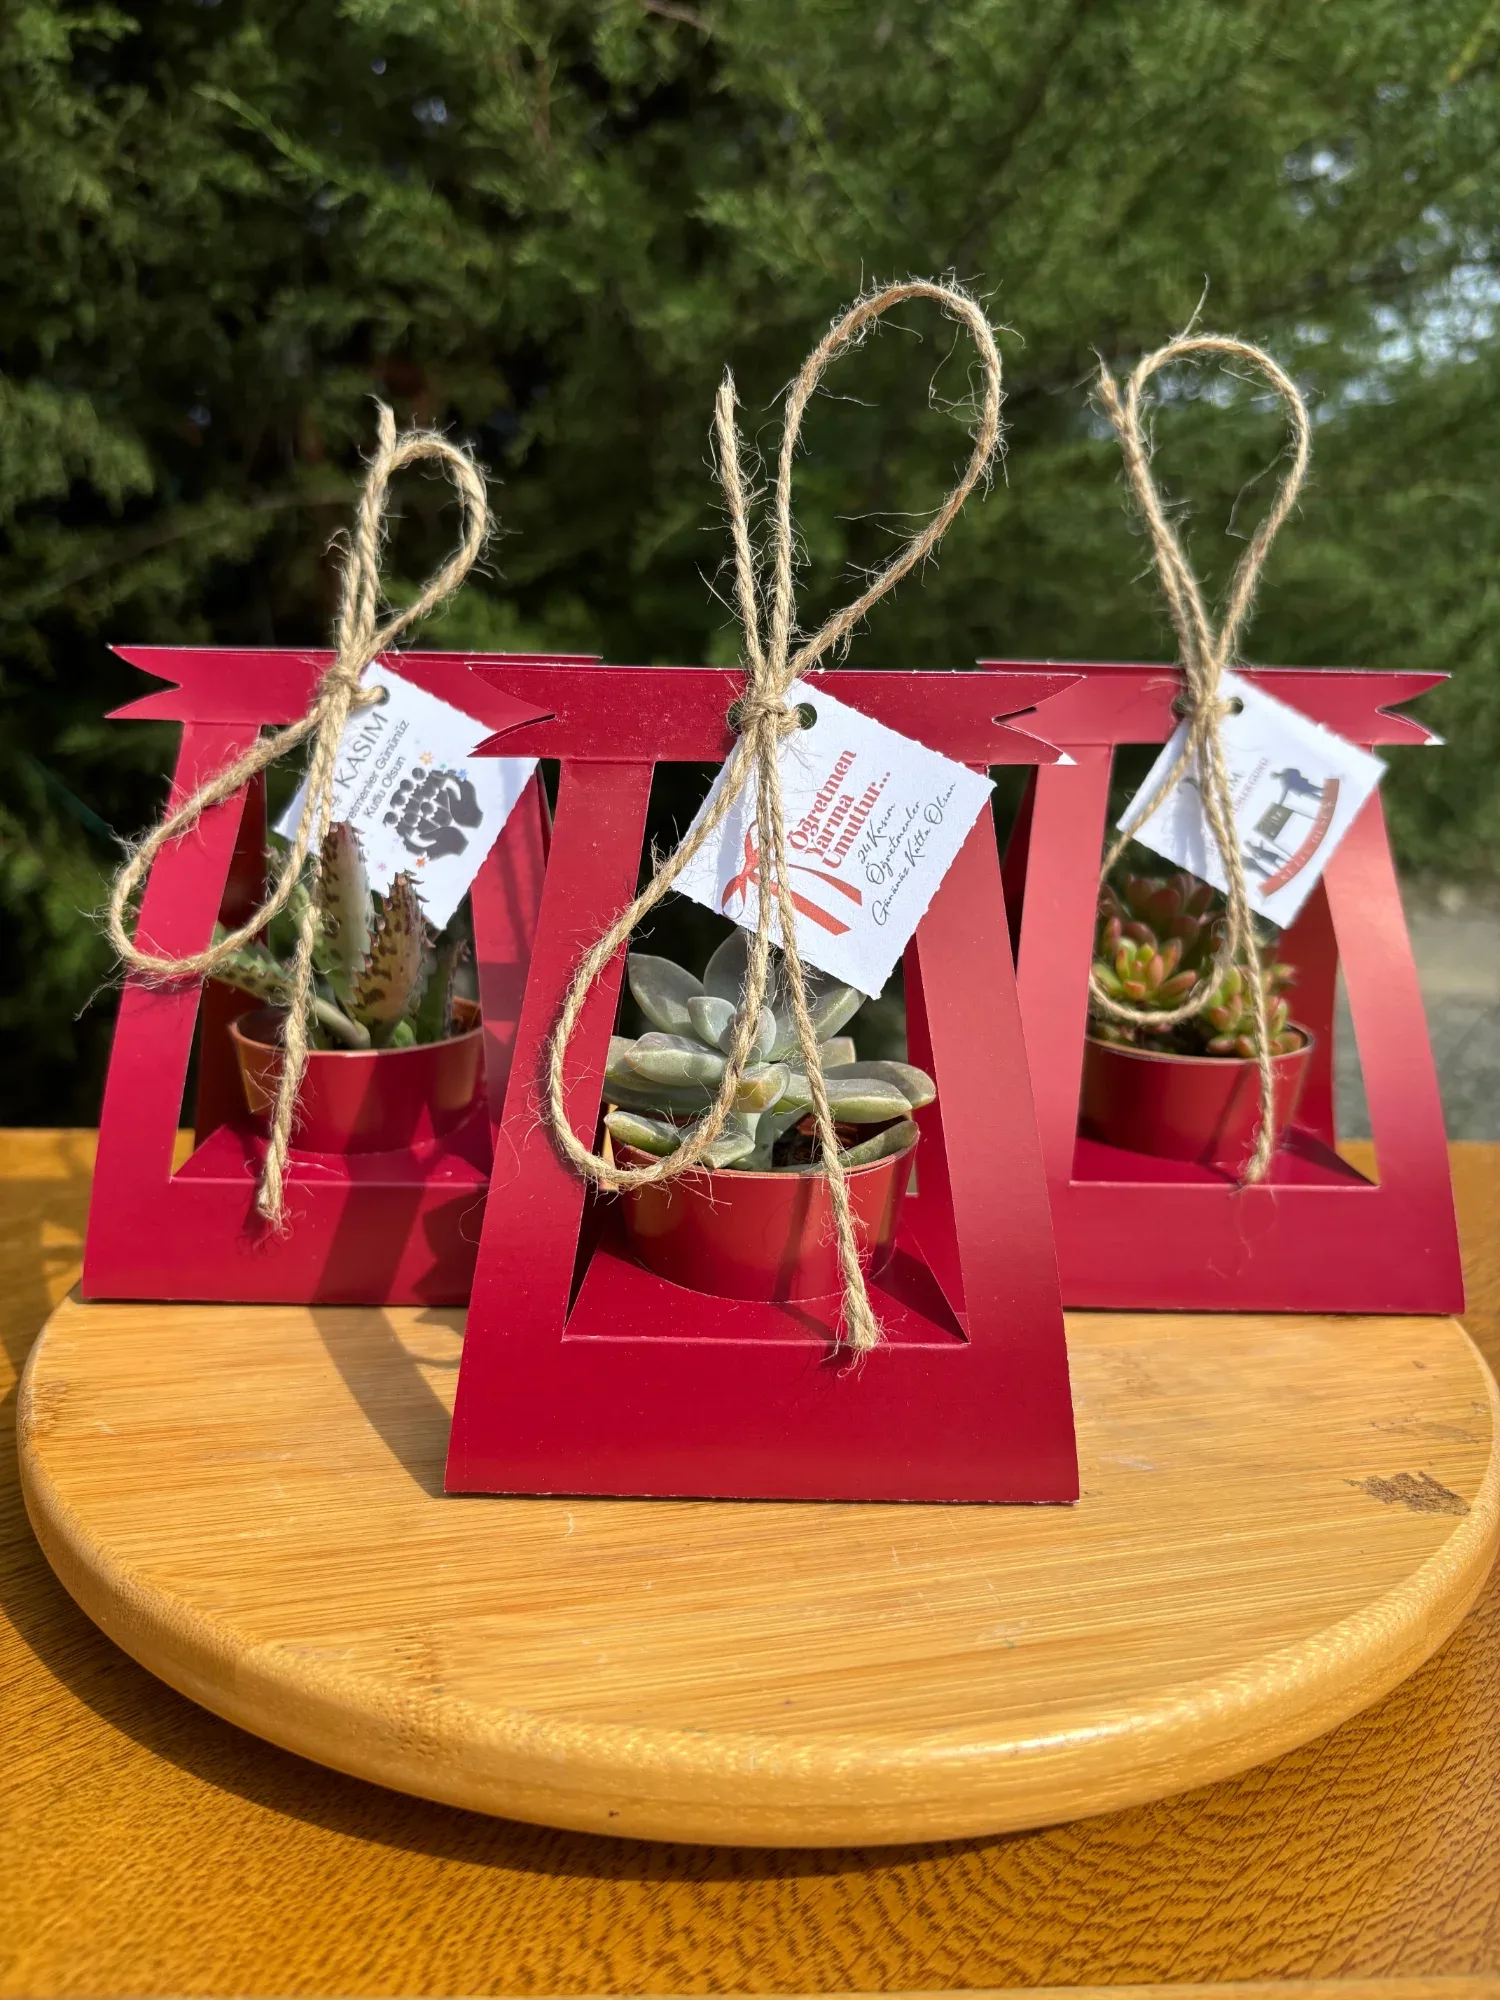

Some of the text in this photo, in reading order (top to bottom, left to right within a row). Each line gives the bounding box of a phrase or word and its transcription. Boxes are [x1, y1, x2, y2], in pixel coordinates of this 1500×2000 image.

[335, 711, 389, 789] KASIM
[375, 719, 410, 769] Gününüz
[382, 755, 406, 788] Olsun
[787, 750, 857, 850] Öğretmen
[805, 794, 855, 857] Yarına
[822, 772, 891, 869] Umuttur...
[858, 803, 896, 865] 24 Kasım
[865, 800, 920, 885] Öğretmenler
[872, 782, 956, 926] Gününüz Kutlu Olsun
